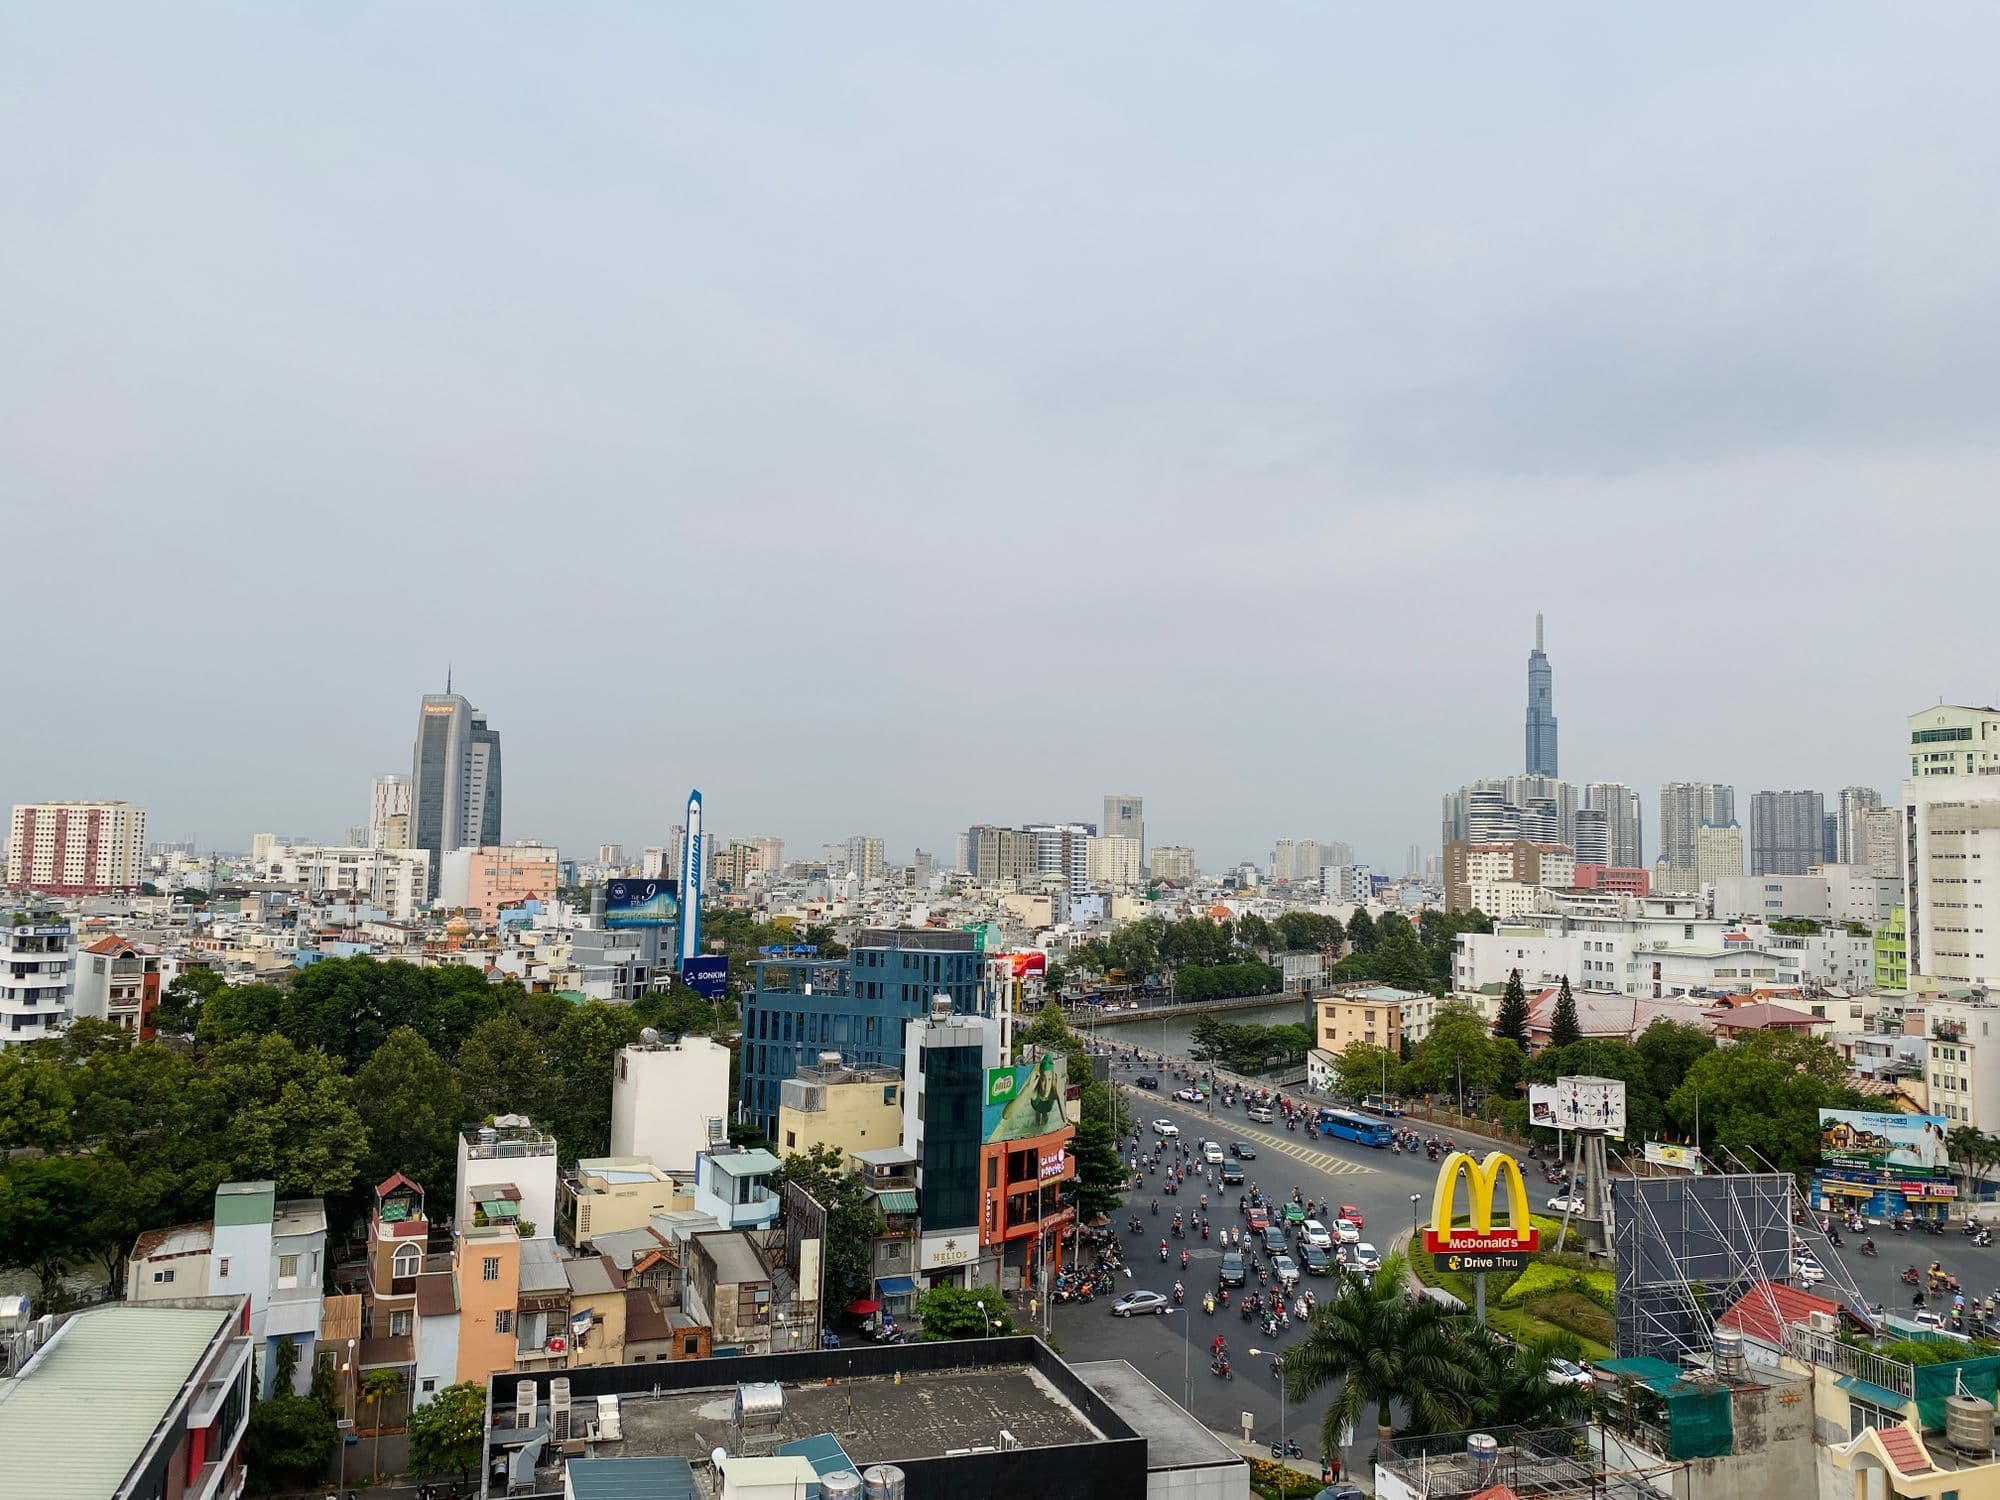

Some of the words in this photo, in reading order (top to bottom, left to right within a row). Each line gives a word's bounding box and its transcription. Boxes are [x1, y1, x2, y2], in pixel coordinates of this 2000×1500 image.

[697, 971, 727, 980] SONKIM
[1040, 1161, 1065, 1179] POPEYES
[1449, 1238, 1519, 1249] McDonald's
[933, 1250, 968, 1262] HELIOS
[1464, 1257, 1493, 1268] Drive
[1495, 1256, 1518, 1267] Thru
